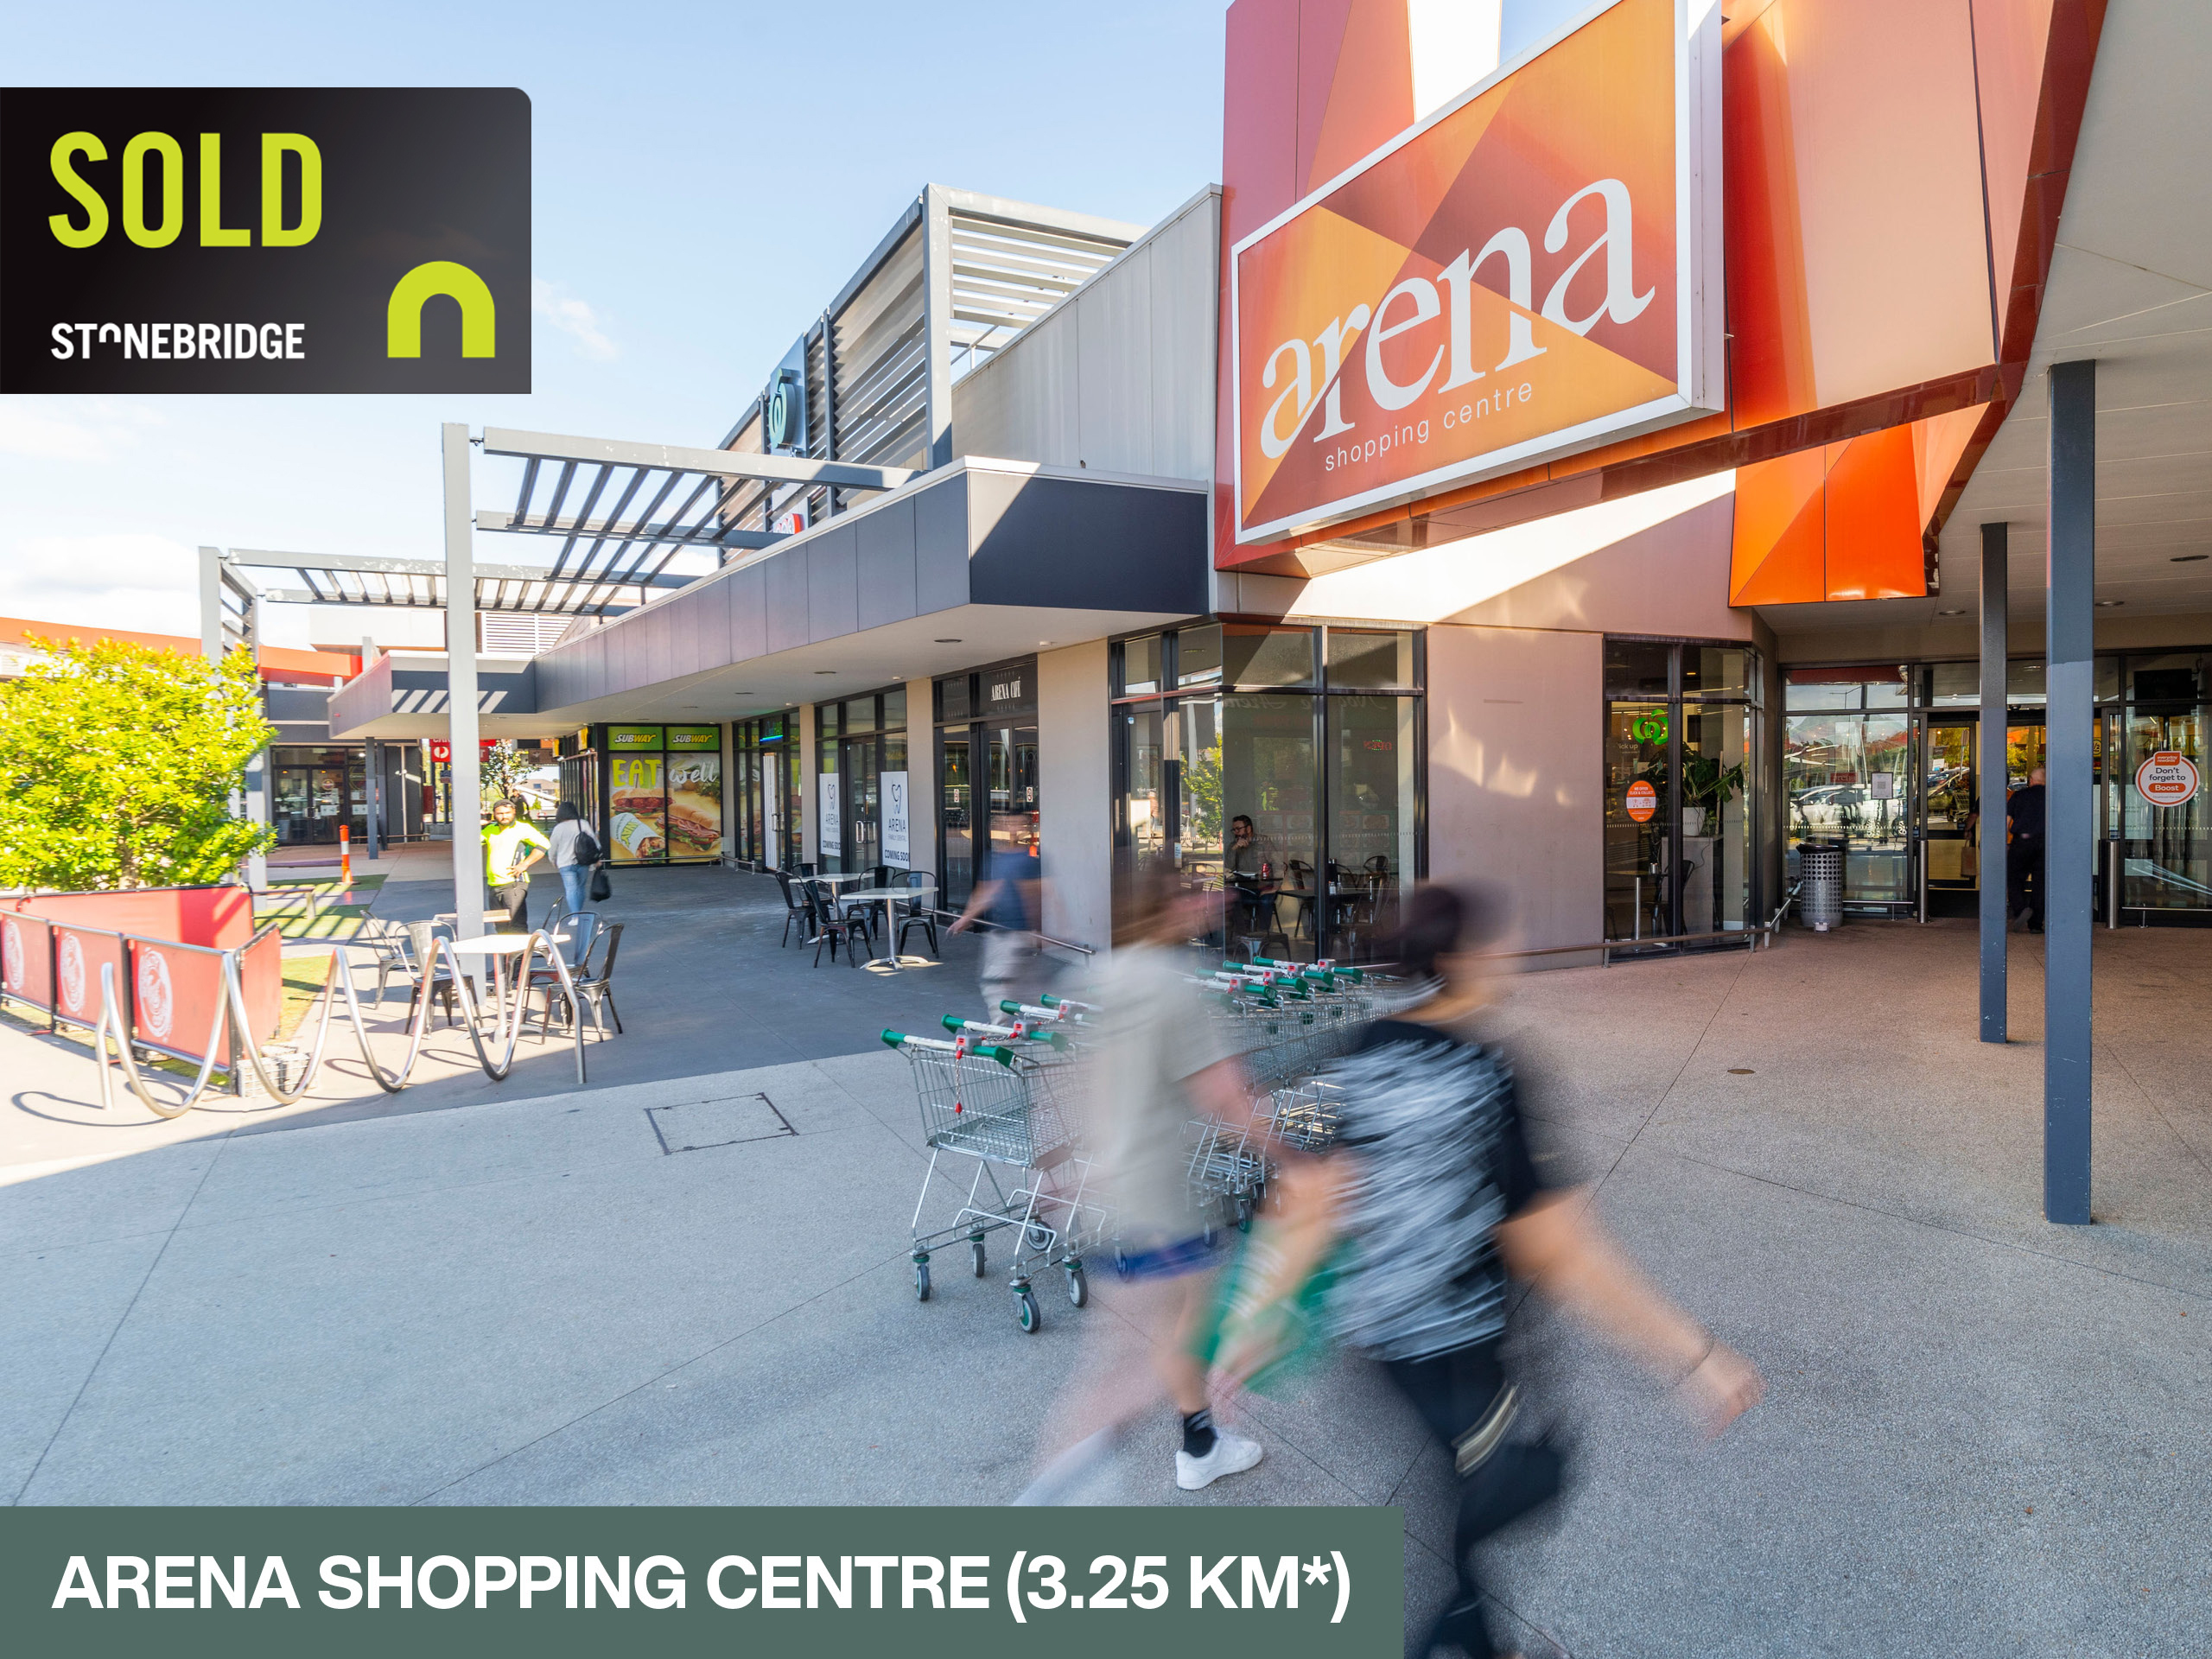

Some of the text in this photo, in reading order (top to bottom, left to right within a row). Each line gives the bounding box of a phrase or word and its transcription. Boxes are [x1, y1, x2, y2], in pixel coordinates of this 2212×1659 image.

[1260, 178, 1656, 459] arena
[1325, 381, 1533, 472] shopping centre
[990, 683, 1009, 701] ARENA
[614, 733, 657, 743] SUBWAY
[672, 734, 713, 744] SUBWAY
[613, 759, 717, 787] EAT well
[888, 818, 906, 832] ARENA
[885, 849, 899, 861] COMING
